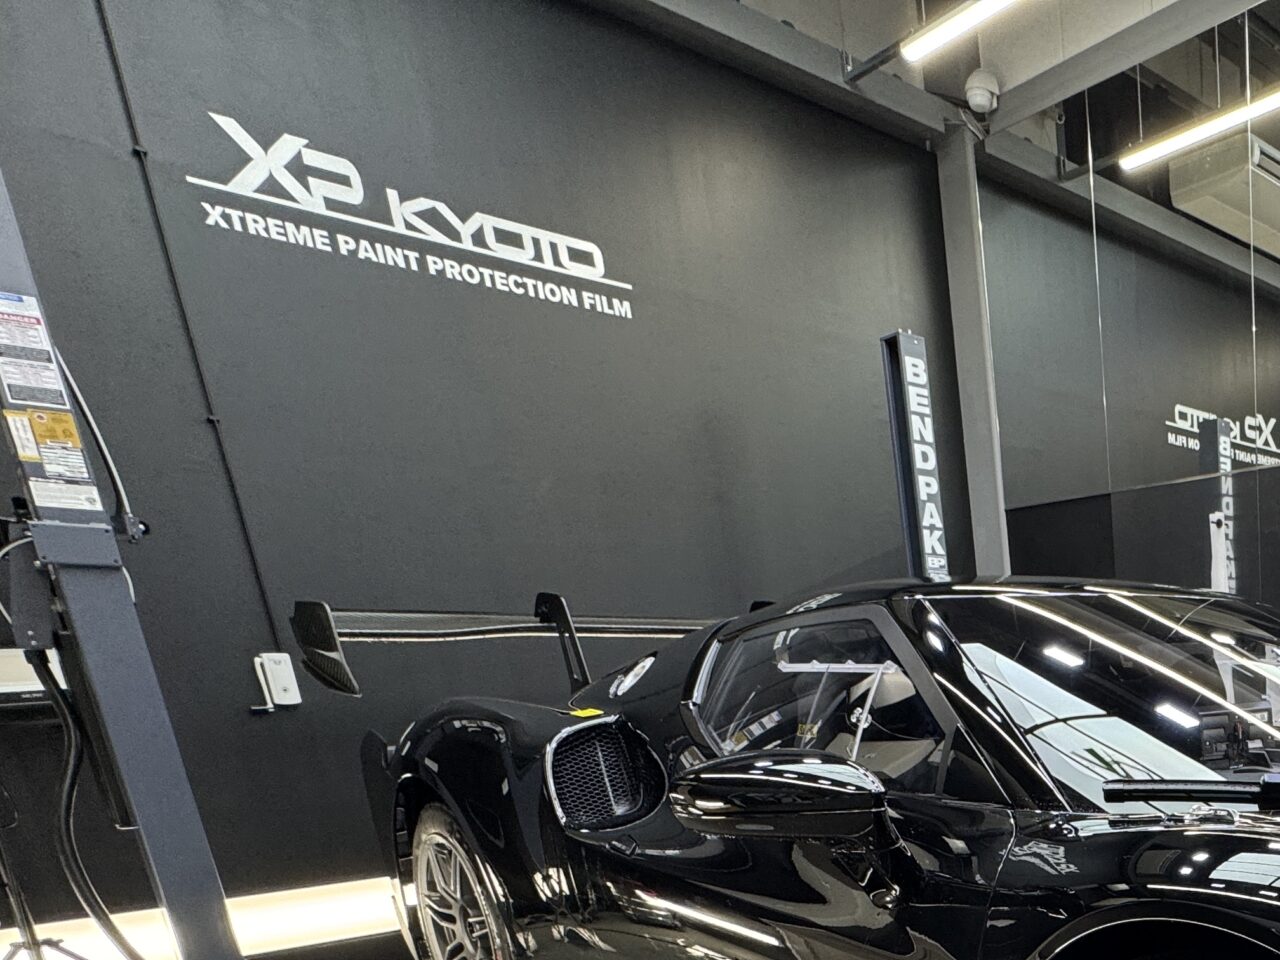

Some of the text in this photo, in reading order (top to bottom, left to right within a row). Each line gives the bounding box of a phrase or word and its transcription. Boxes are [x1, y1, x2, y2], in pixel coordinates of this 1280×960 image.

[201, 202, 633, 318] XTREME PAINT PROTECTION FILM
[207, 112, 605, 279] XP KYOTO
[905, 356, 946, 555] BENDPAK
